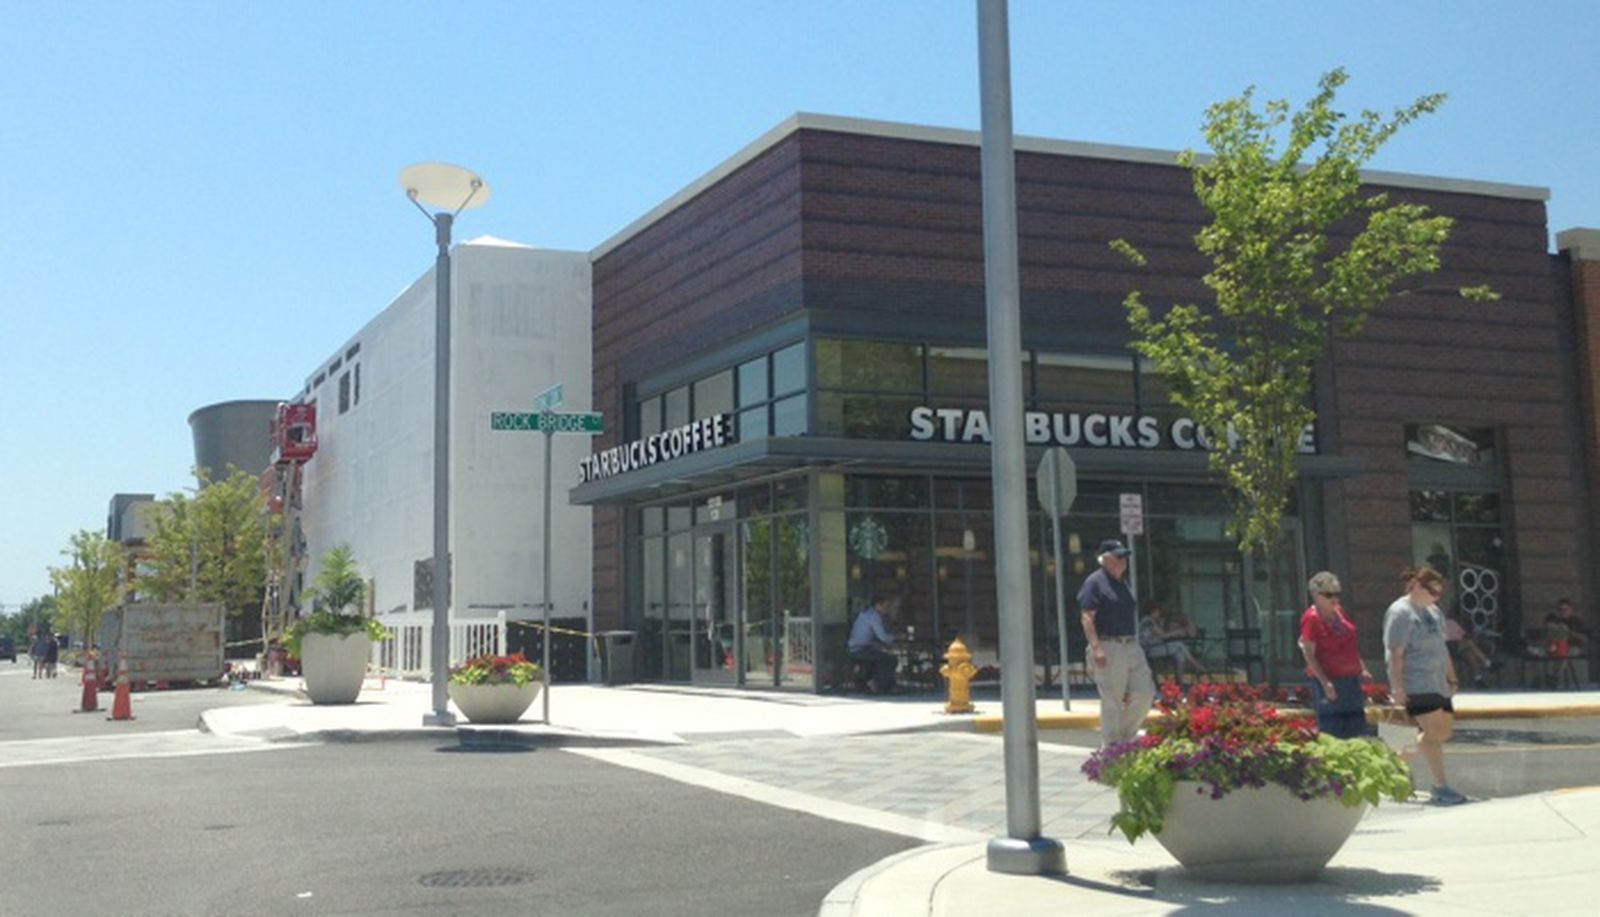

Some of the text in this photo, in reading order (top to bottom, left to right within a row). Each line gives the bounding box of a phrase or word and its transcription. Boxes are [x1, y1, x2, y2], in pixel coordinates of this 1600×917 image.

[494, 412, 531, 431] ROCK
[540, 414, 586, 432] BRIDGE
[910, 406, 1159, 448] STABUCKS
[578, 413, 724, 482] STARBUCKS COFFEE
